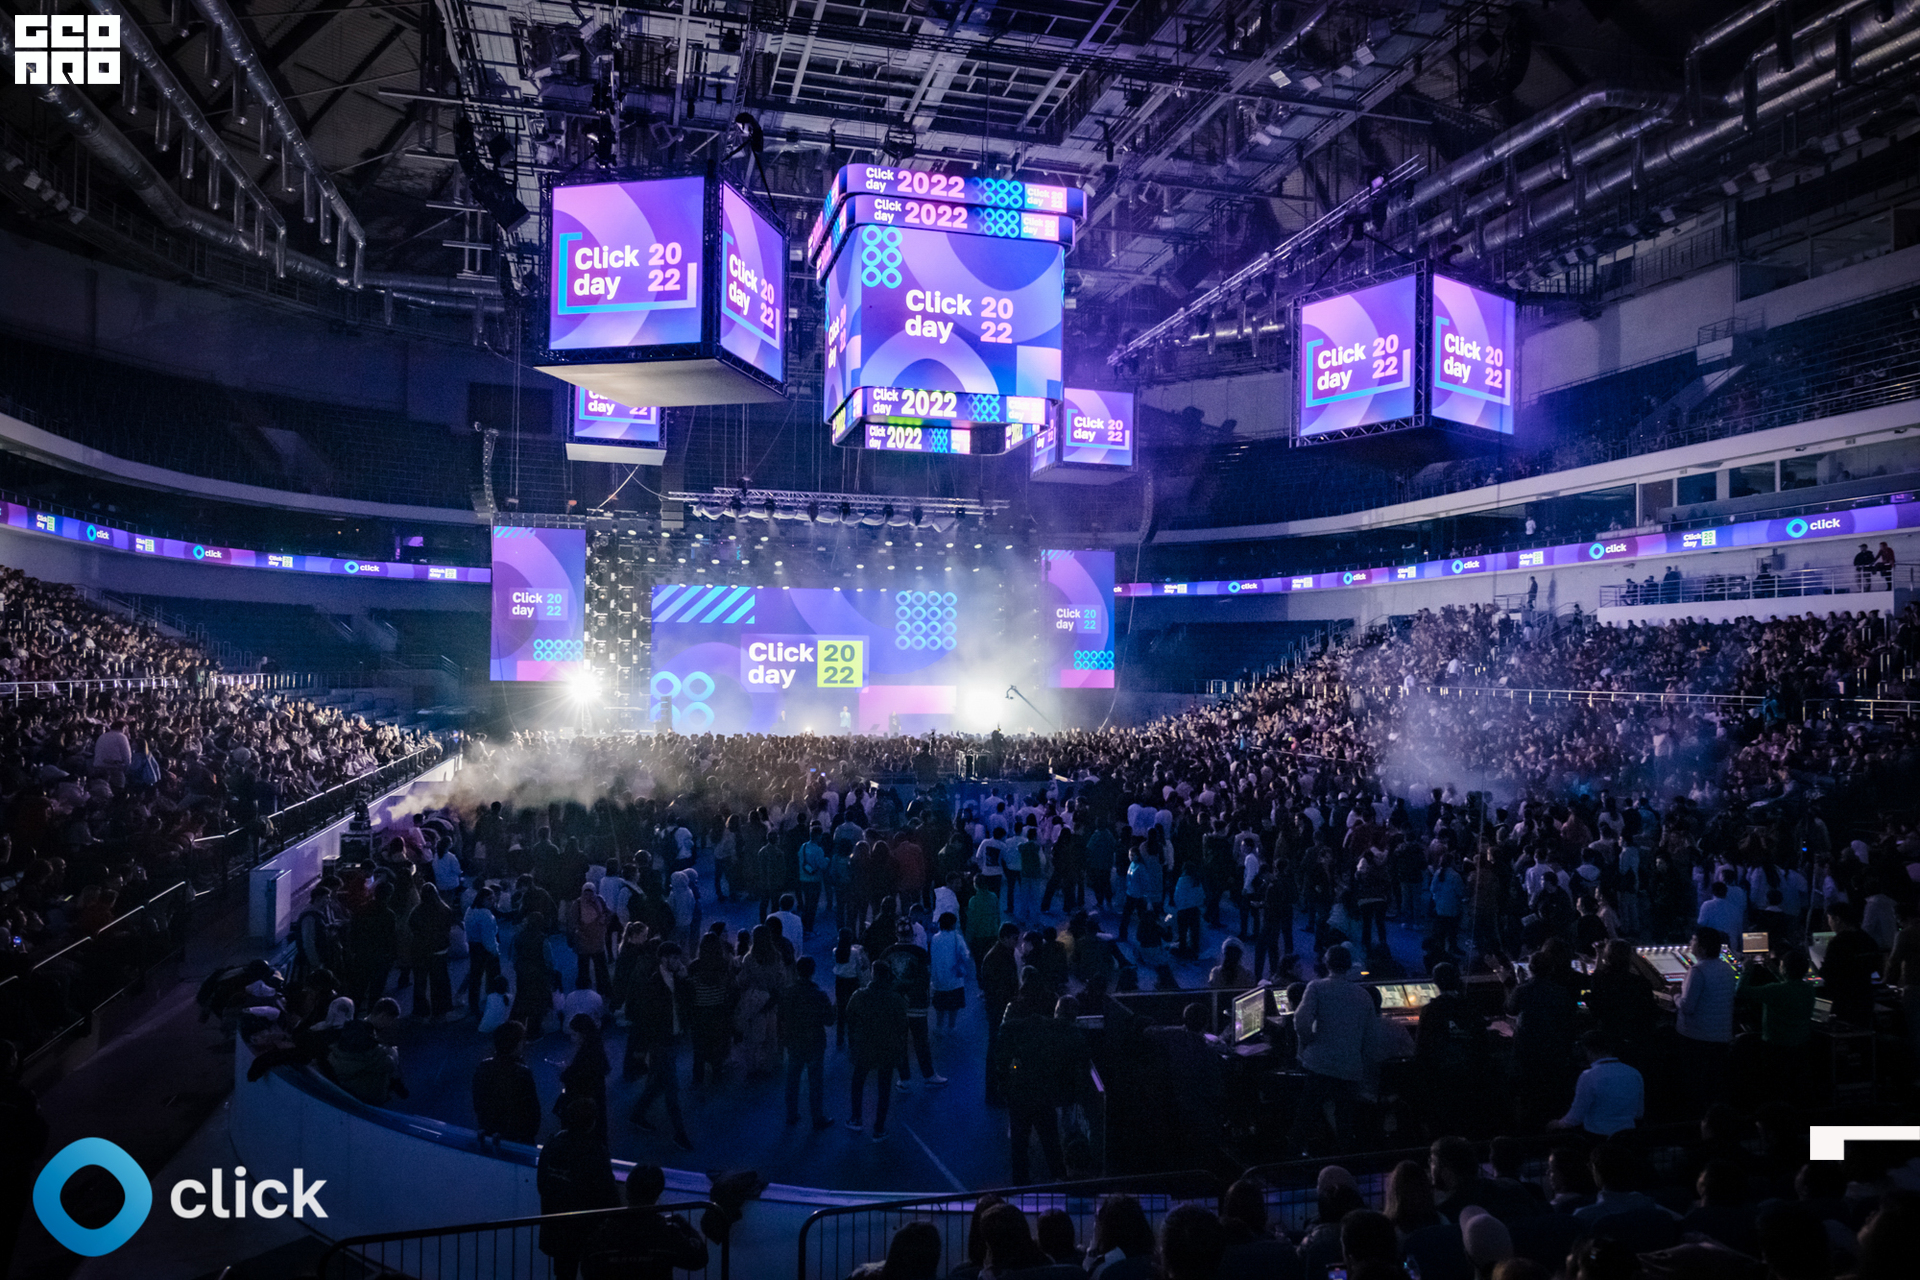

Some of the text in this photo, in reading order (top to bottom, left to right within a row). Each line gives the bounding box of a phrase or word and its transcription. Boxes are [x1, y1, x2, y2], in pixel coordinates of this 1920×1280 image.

[866, 167, 895, 180] Click
[866, 178, 886, 193] day
[897, 170, 965, 198] 2022
[1026, 188, 1050, 198] Click
[874, 198, 902, 212] Click
[1026, 197, 1044, 207] day
[874, 209, 894, 224] day
[904, 201, 968, 229] 2022
[1022, 226, 1039, 236] day
[574, 242, 682, 270] Click 20
[573, 268, 681, 300] day 22
[728, 253, 775, 305] Click 20
[728, 281, 775, 329] day 22
[905, 289, 1014, 319] Click 20
[905, 315, 1013, 344] day 22
[1317, 334, 1399, 370] Click 20
[1444, 333, 1503, 367] Click 20
[1317, 356, 1398, 391] day 22
[1444, 356, 1502, 389] day 22
[873, 388, 899, 401] Click
[587, 400, 615, 416] day
[872, 402, 892, 416] day
[901, 389, 957, 418] 2022
[869, 425, 886, 437] Click
[1073, 416, 1124, 431] Click 20
[886, 425, 922, 450] 2022
[1073, 428, 1123, 443] day 22
[869, 438, 882, 450] day
[1810, 518, 1841, 531] click
[96, 530, 110, 540] click
[1683, 533, 1702, 541] Click
[205, 550, 222, 558] click
[1605, 543, 1627, 553] click
[360, 564, 380, 572] click
[1463, 560, 1480, 569] click
[1353, 573, 1366, 581] click
[512, 592, 562, 604] Click 20
[512, 604, 562, 619] day 22
[1056, 608, 1097, 620] Click 20
[1056, 618, 1096, 632] day 22
[749, 642, 855, 663] Click 20
[748, 664, 855, 686] day 22
